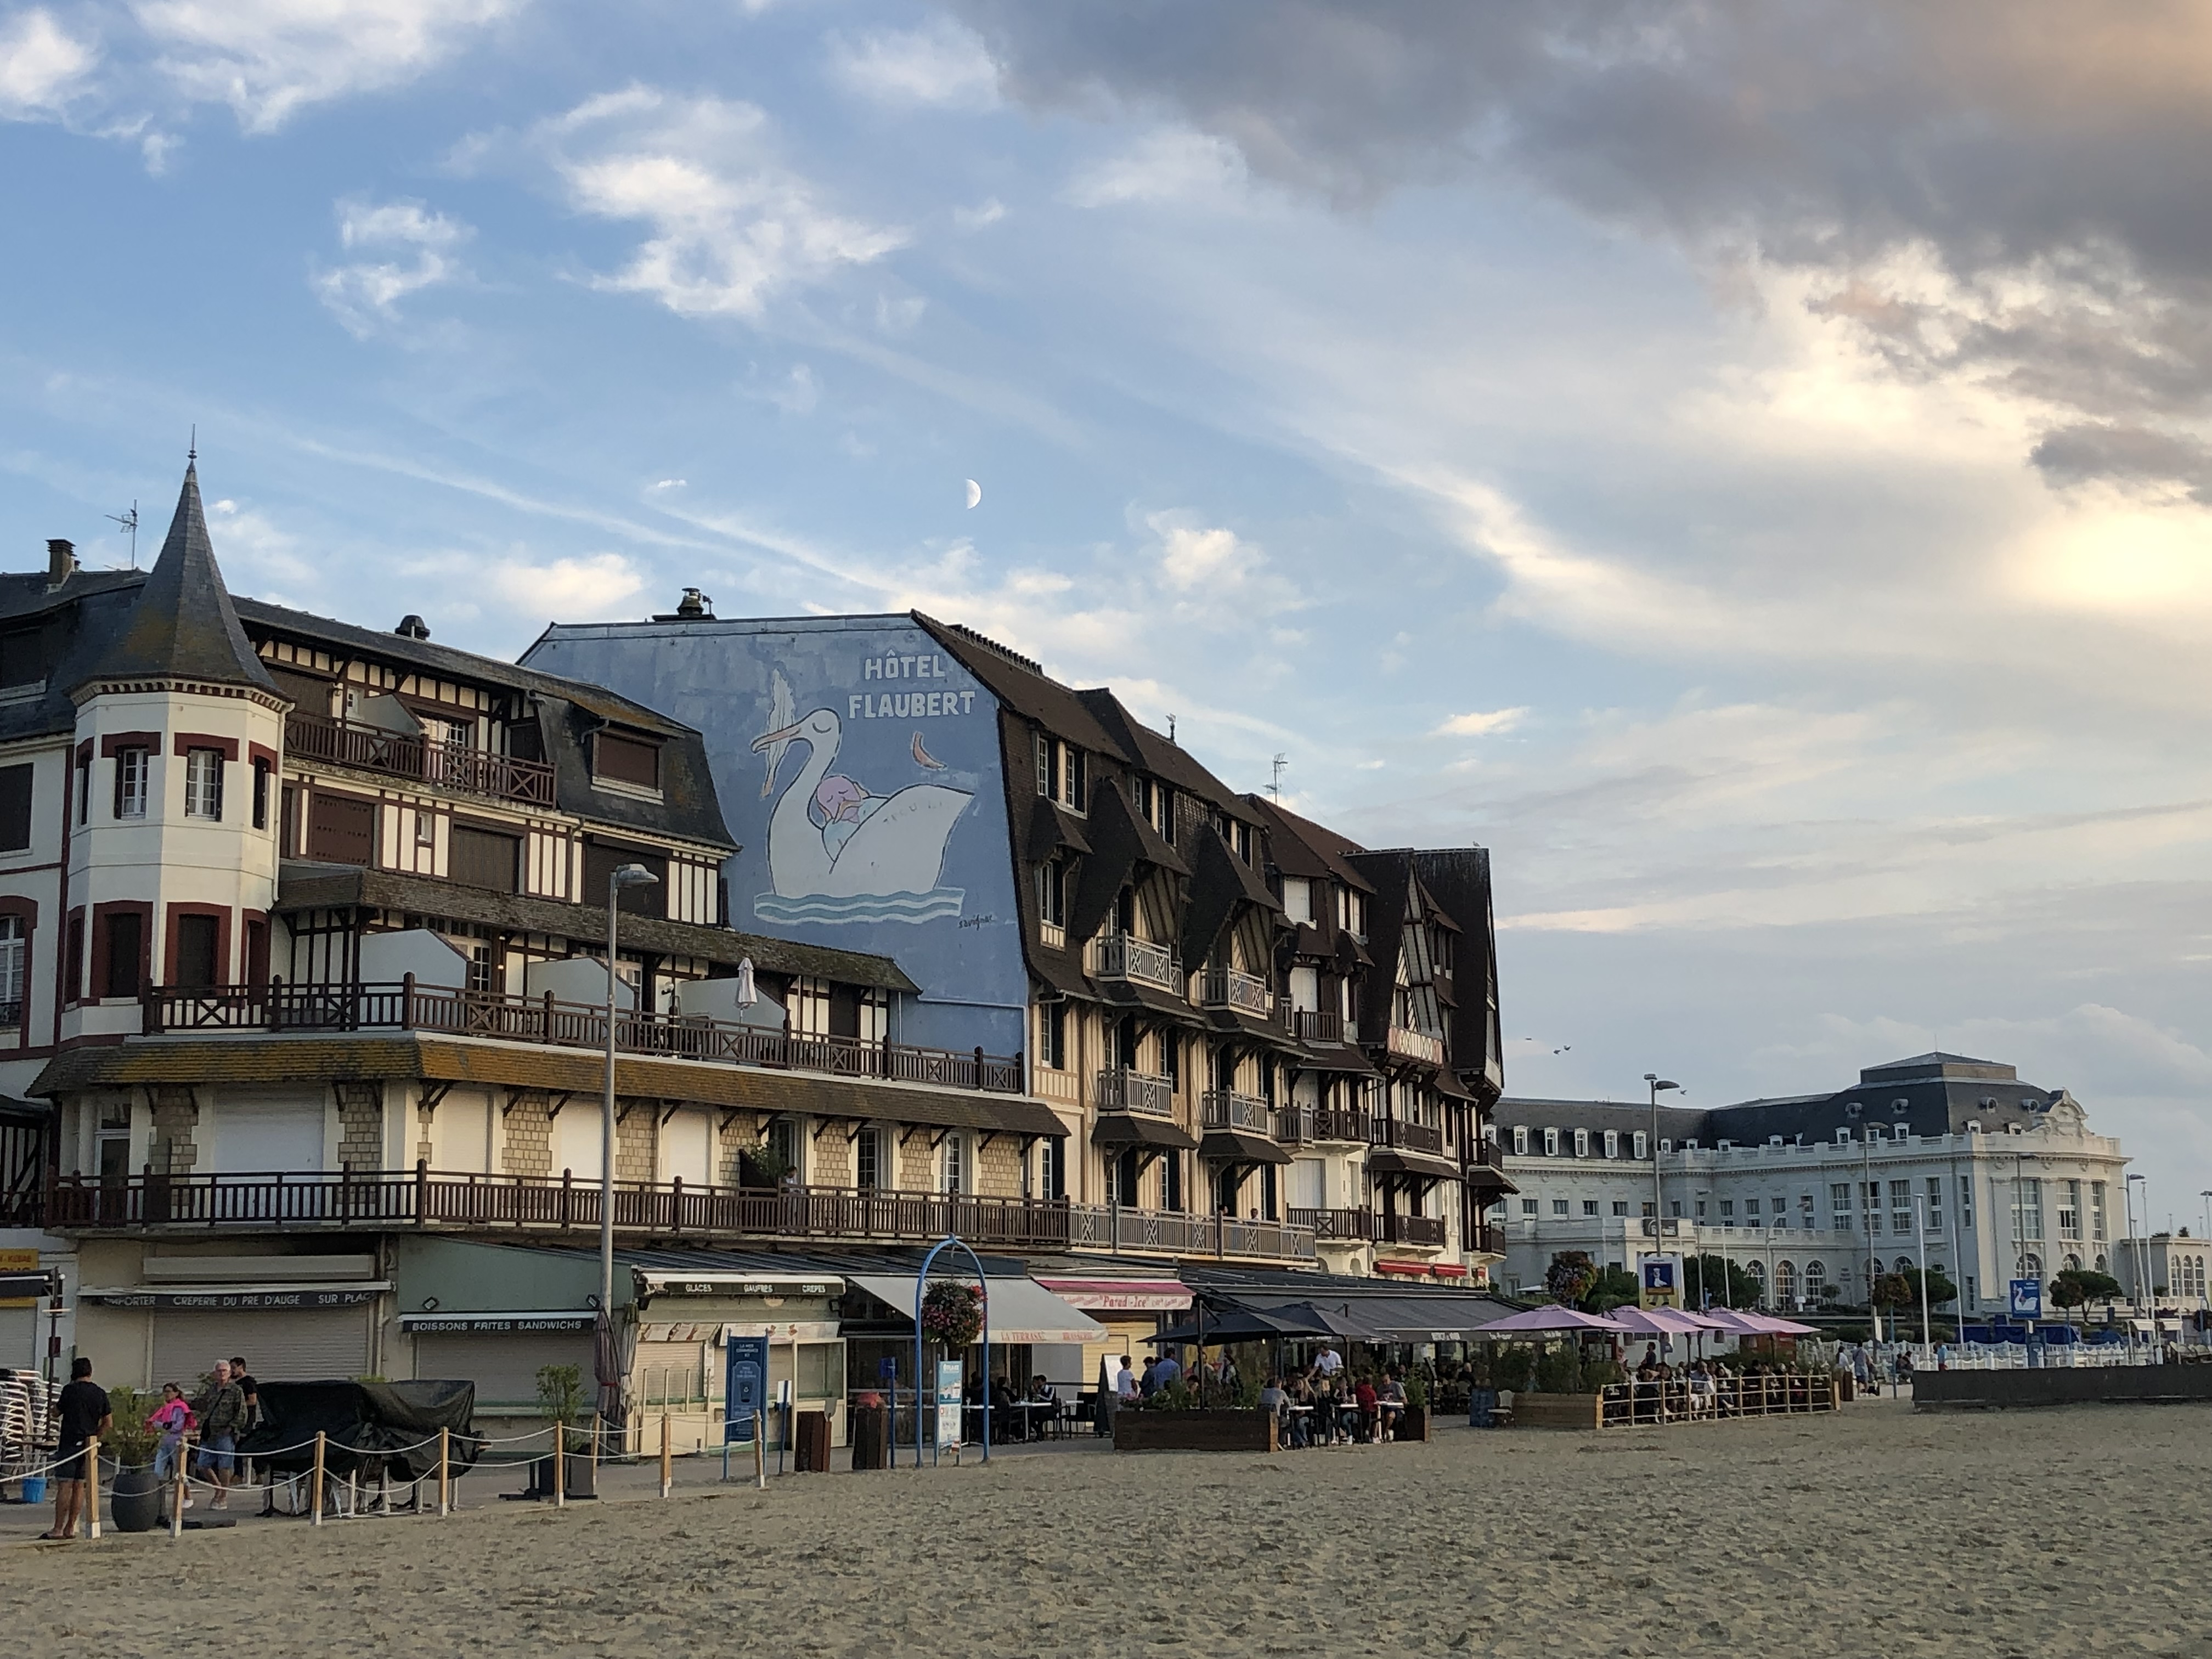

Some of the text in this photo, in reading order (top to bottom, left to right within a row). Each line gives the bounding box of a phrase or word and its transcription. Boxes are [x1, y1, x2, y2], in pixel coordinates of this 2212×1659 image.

[865, 649, 946, 680] HÔTEL
[849, 691, 975, 719] FLAUBERT
[686, 1284, 713, 1293] GLACES
[173, 1296, 218, 1306] CREPERIE
[223, 1296, 237, 1306] DU
[242, 1295, 259, 1305] PRE
[264, 1295, 300, 1305] D'AUGE
[318, 1294, 338, 1304] SUR
[412, 1321, 582, 1331] BOISSONS FRITES SANDWICHS
